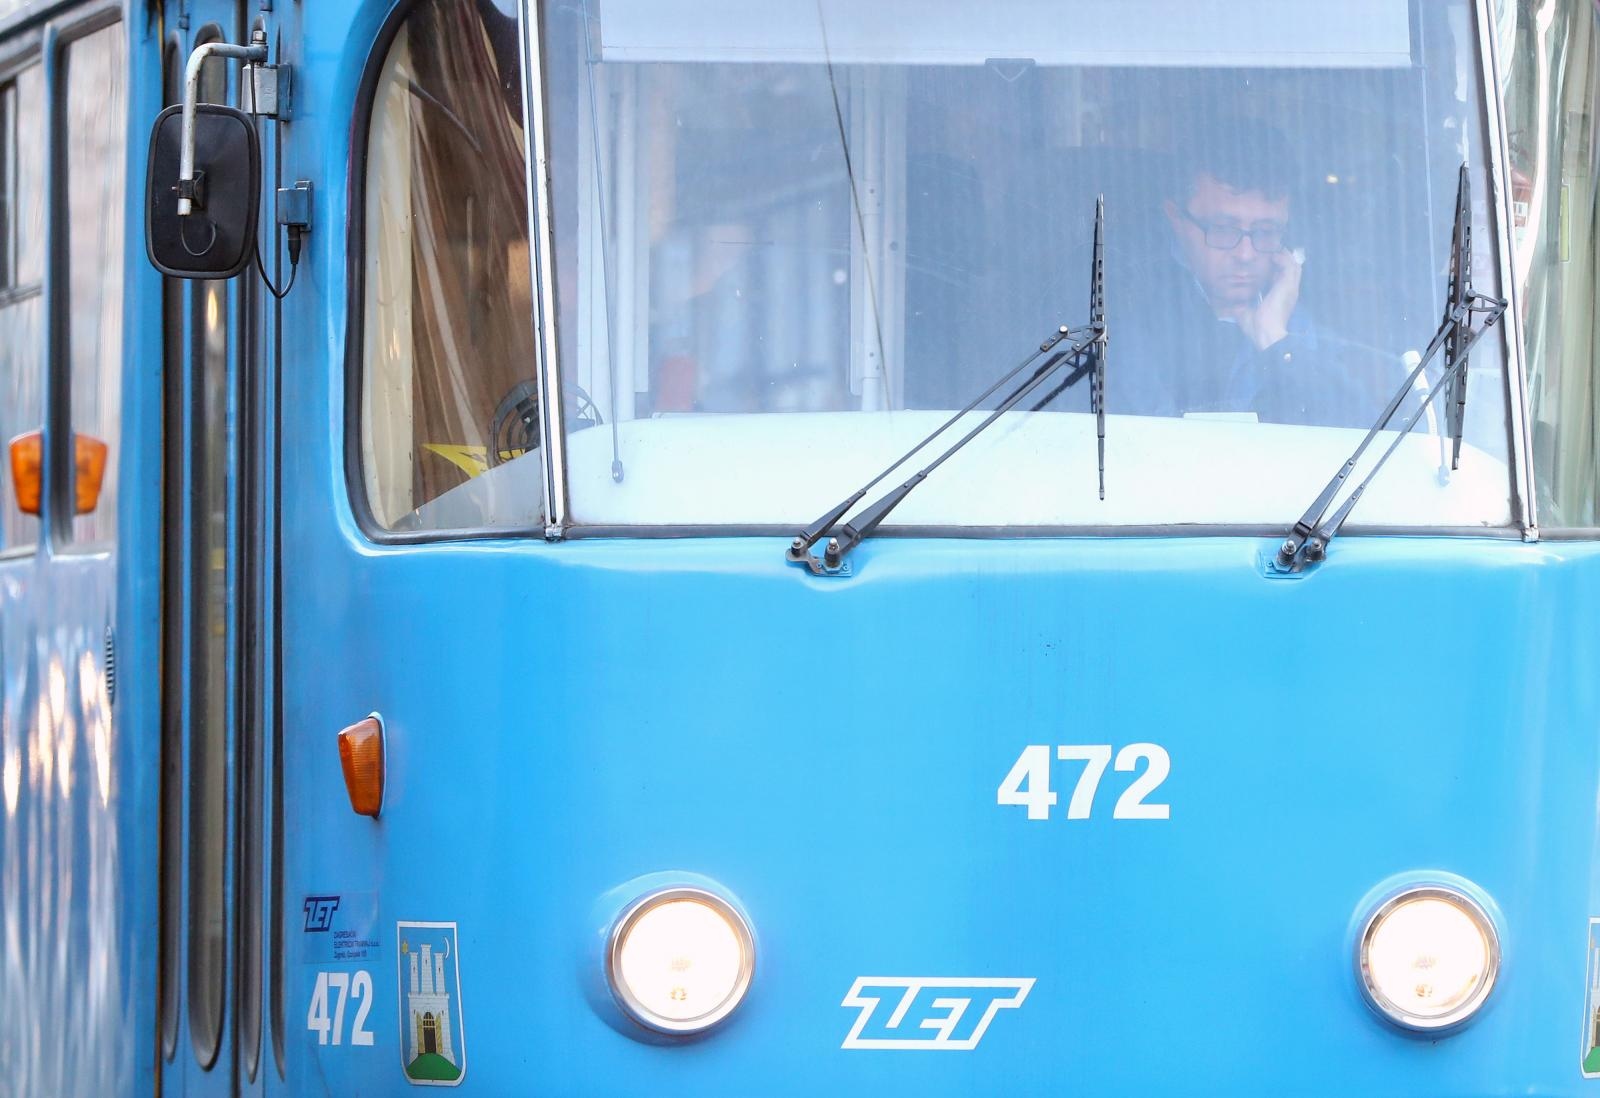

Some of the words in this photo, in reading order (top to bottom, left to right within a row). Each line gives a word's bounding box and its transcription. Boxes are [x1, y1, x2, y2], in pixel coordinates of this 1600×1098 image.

[997, 742, 1171, 820] 472
[304, 895, 341, 933] ZET
[307, 969, 375, 1046] 472
[840, 976, 1037, 1050] ZET
